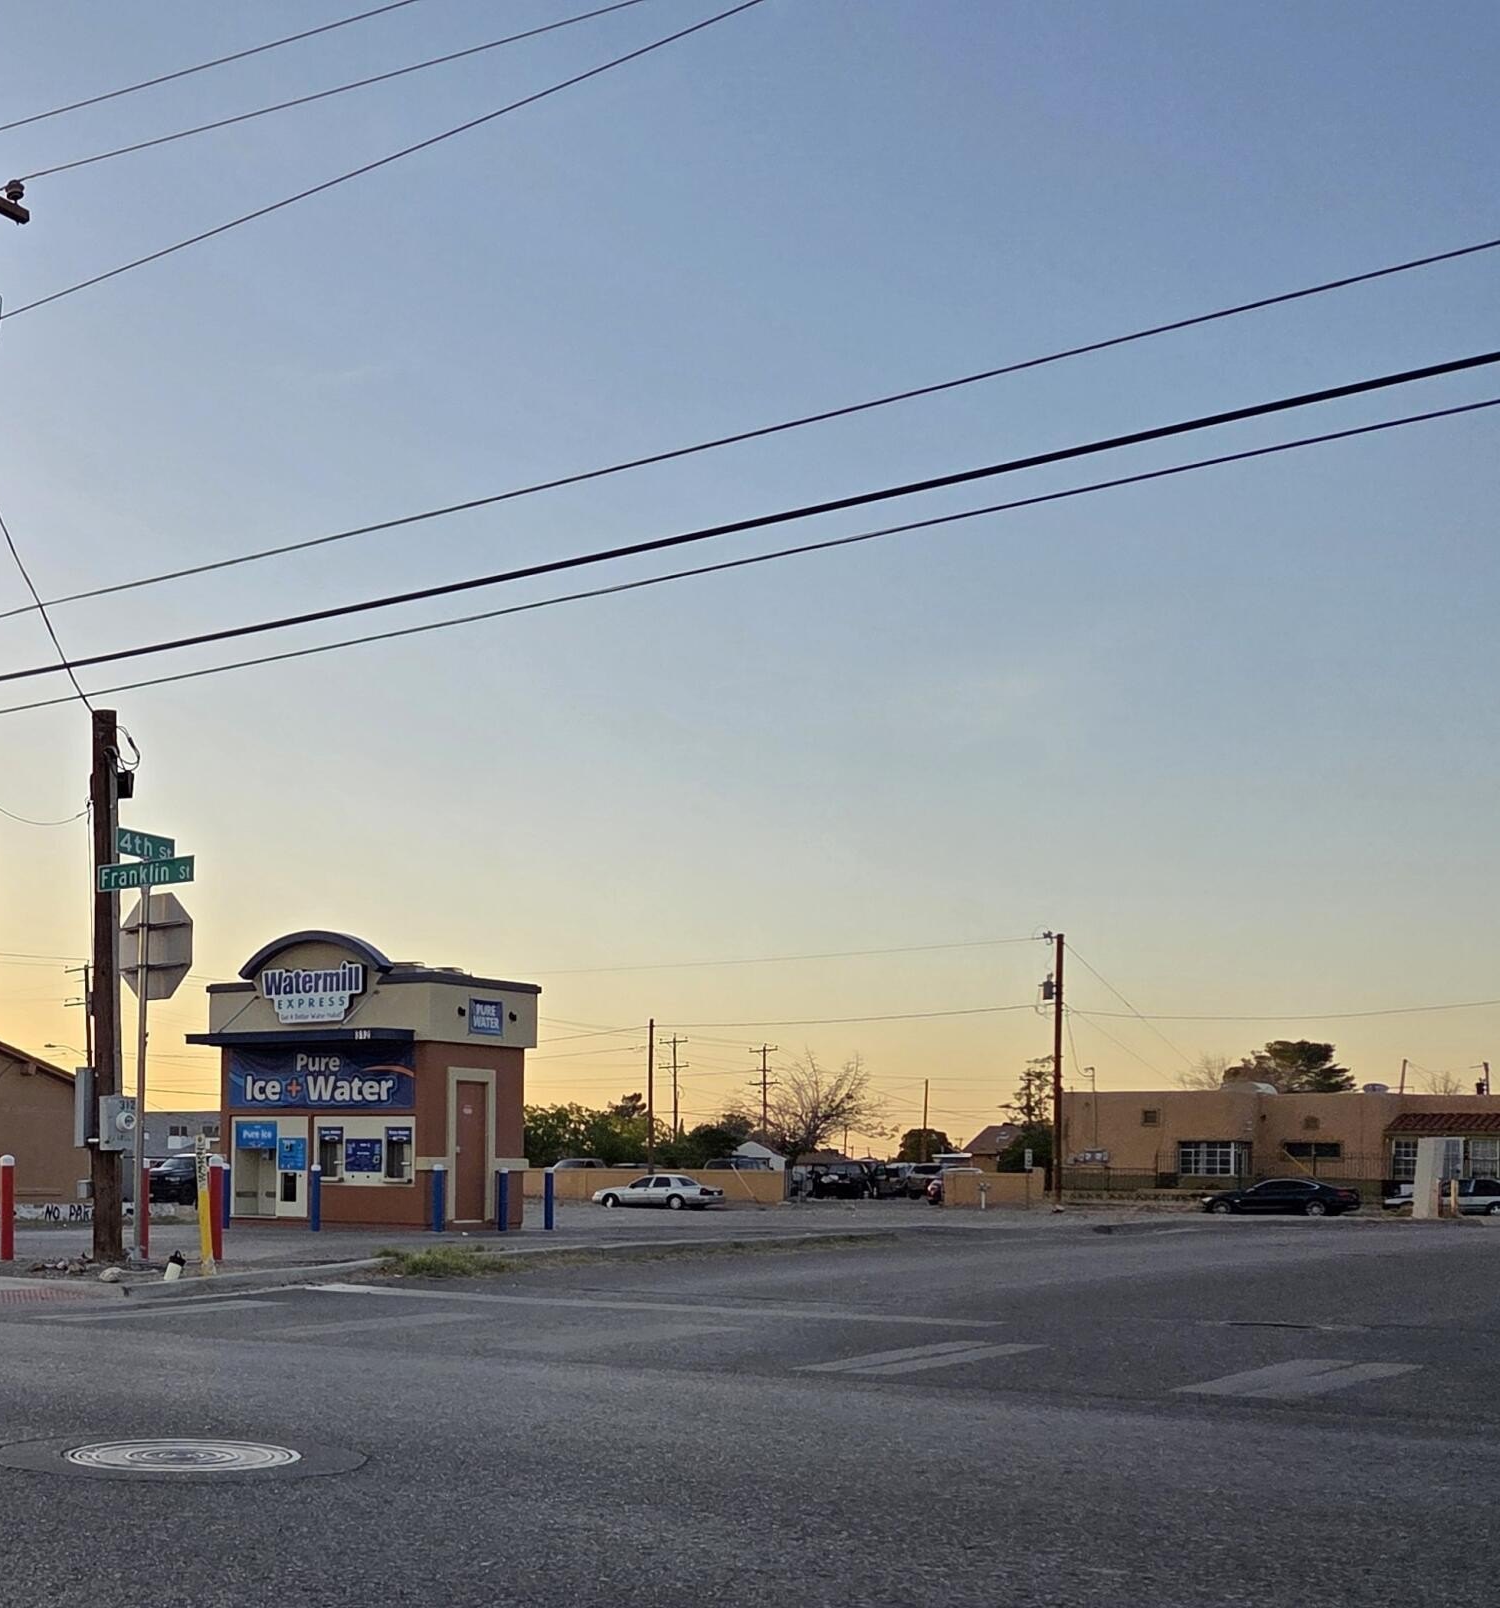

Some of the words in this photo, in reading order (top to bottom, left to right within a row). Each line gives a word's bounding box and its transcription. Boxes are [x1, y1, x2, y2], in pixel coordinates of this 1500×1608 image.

[119, 833, 153, 857] 4th
[159, 846, 172, 859] St
[101, 863, 169, 888] Franklin
[179, 865, 190, 880] St
[263, 961, 361, 996] Watermill
[277, 996, 346, 1010] EXPRESS
[475, 1003, 497, 1017] PURE
[473, 1015, 500, 1029] WATER
[296, 1053, 341, 1072] Pure
[245, 1075, 282, 1101] Ice
[307, 1075, 394, 1102] Water
[44, 1204, 60, 1221] NO
